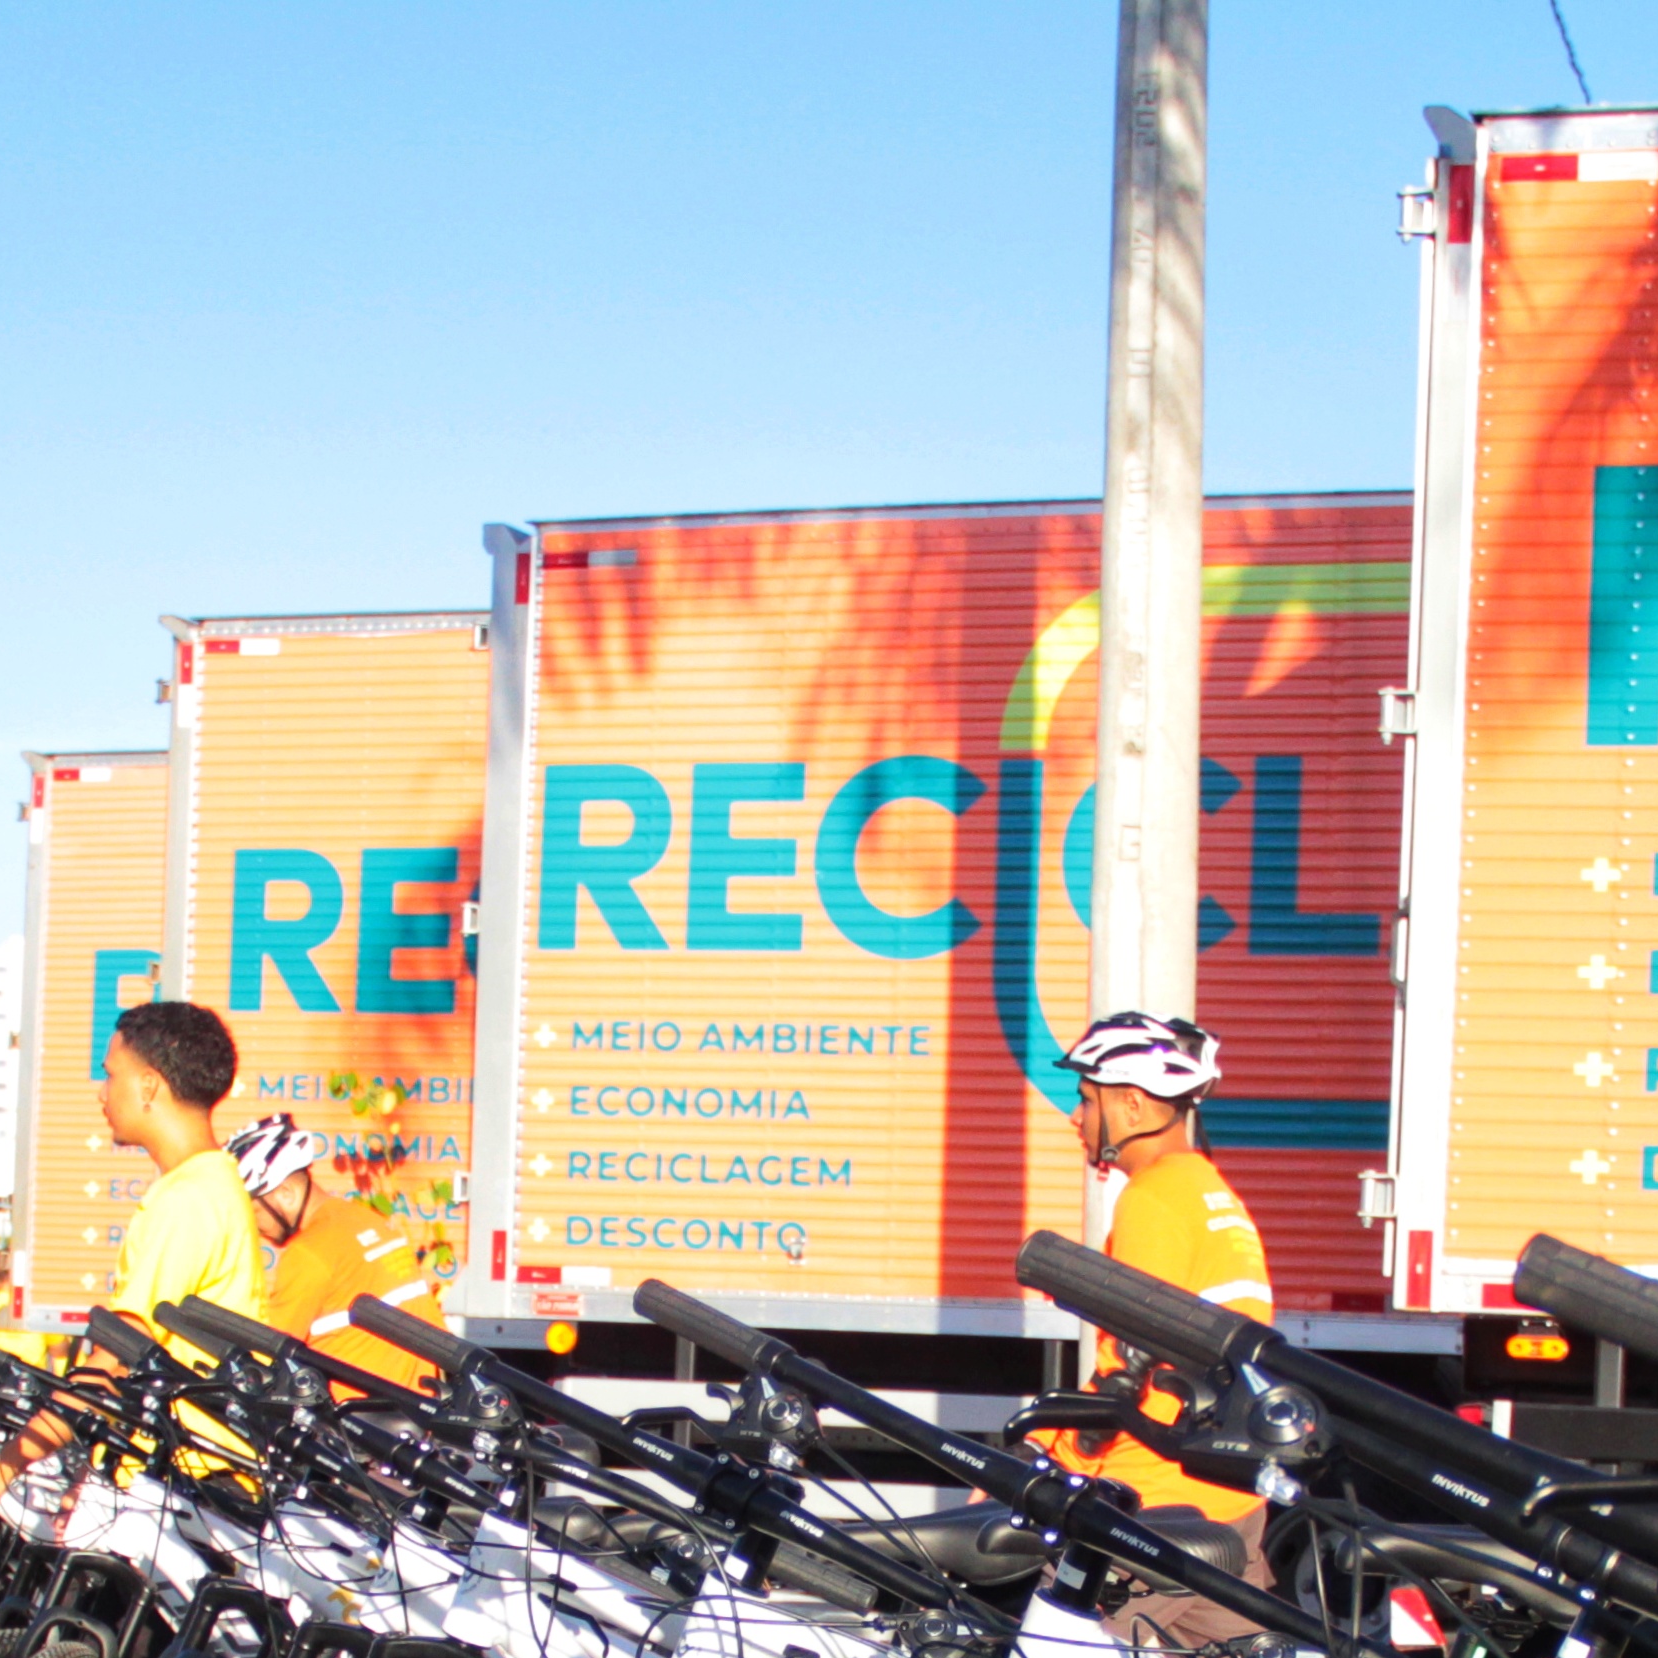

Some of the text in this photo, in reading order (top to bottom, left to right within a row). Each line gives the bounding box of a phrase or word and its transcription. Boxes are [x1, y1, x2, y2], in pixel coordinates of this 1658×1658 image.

[570, 1021, 931, 1057] MEIO AMBIENTE
[568, 1086, 810, 1122] ECONOMIA
[566, 1150, 853, 1188] RECICLAGEM
[564, 1215, 808, 1255] DESCONTO
[941, 1442, 986, 1470] INVIKTUS
[1211, 1440, 1250, 1453] GTS
[1432, 1473, 1490, 1508] INVIKTUS
[1109, 1526, 1160, 1558] INVIKTUS
